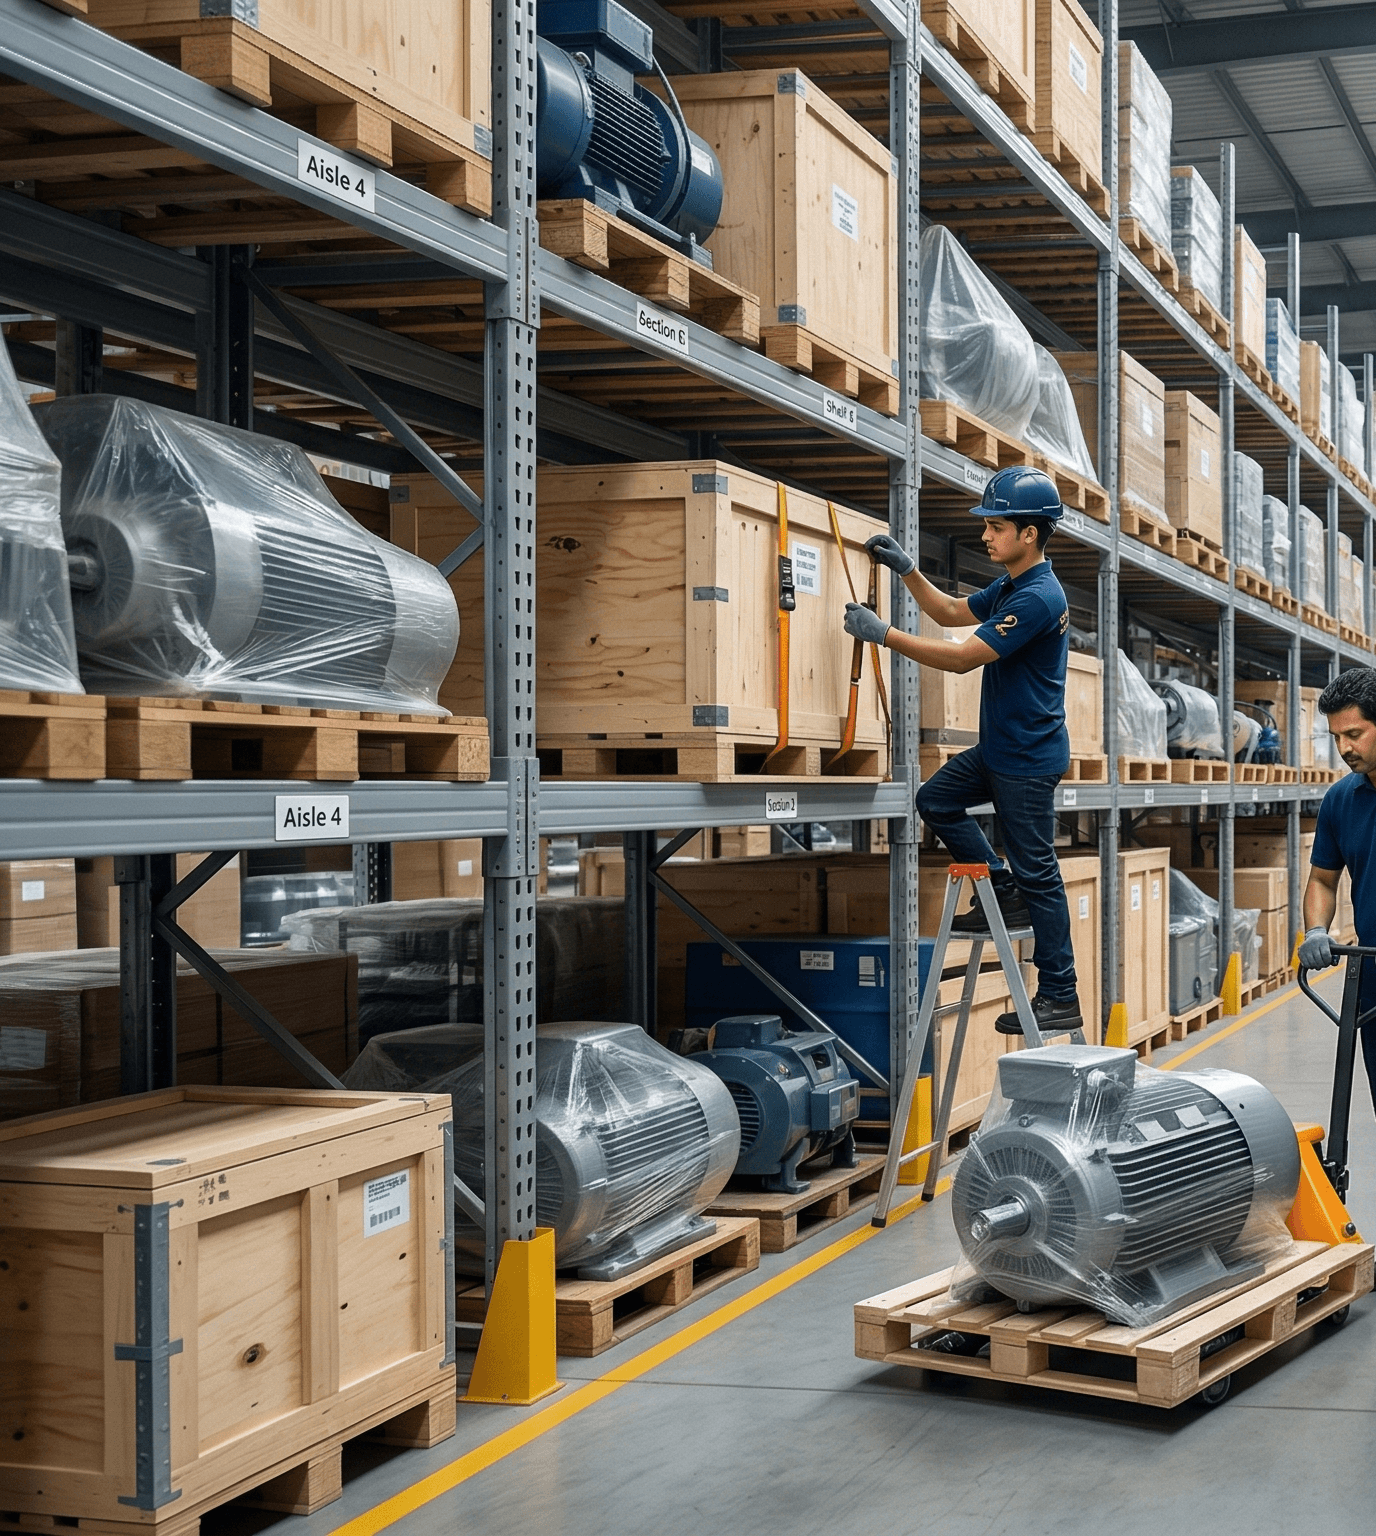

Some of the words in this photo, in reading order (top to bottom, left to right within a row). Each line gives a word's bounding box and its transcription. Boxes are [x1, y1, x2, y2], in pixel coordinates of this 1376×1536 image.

[306, 155, 351, 191] Aisle
[354, 178, 366, 198] 4
[283, 805, 327, 828] Aisle
[330, 806, 342, 826] 4
